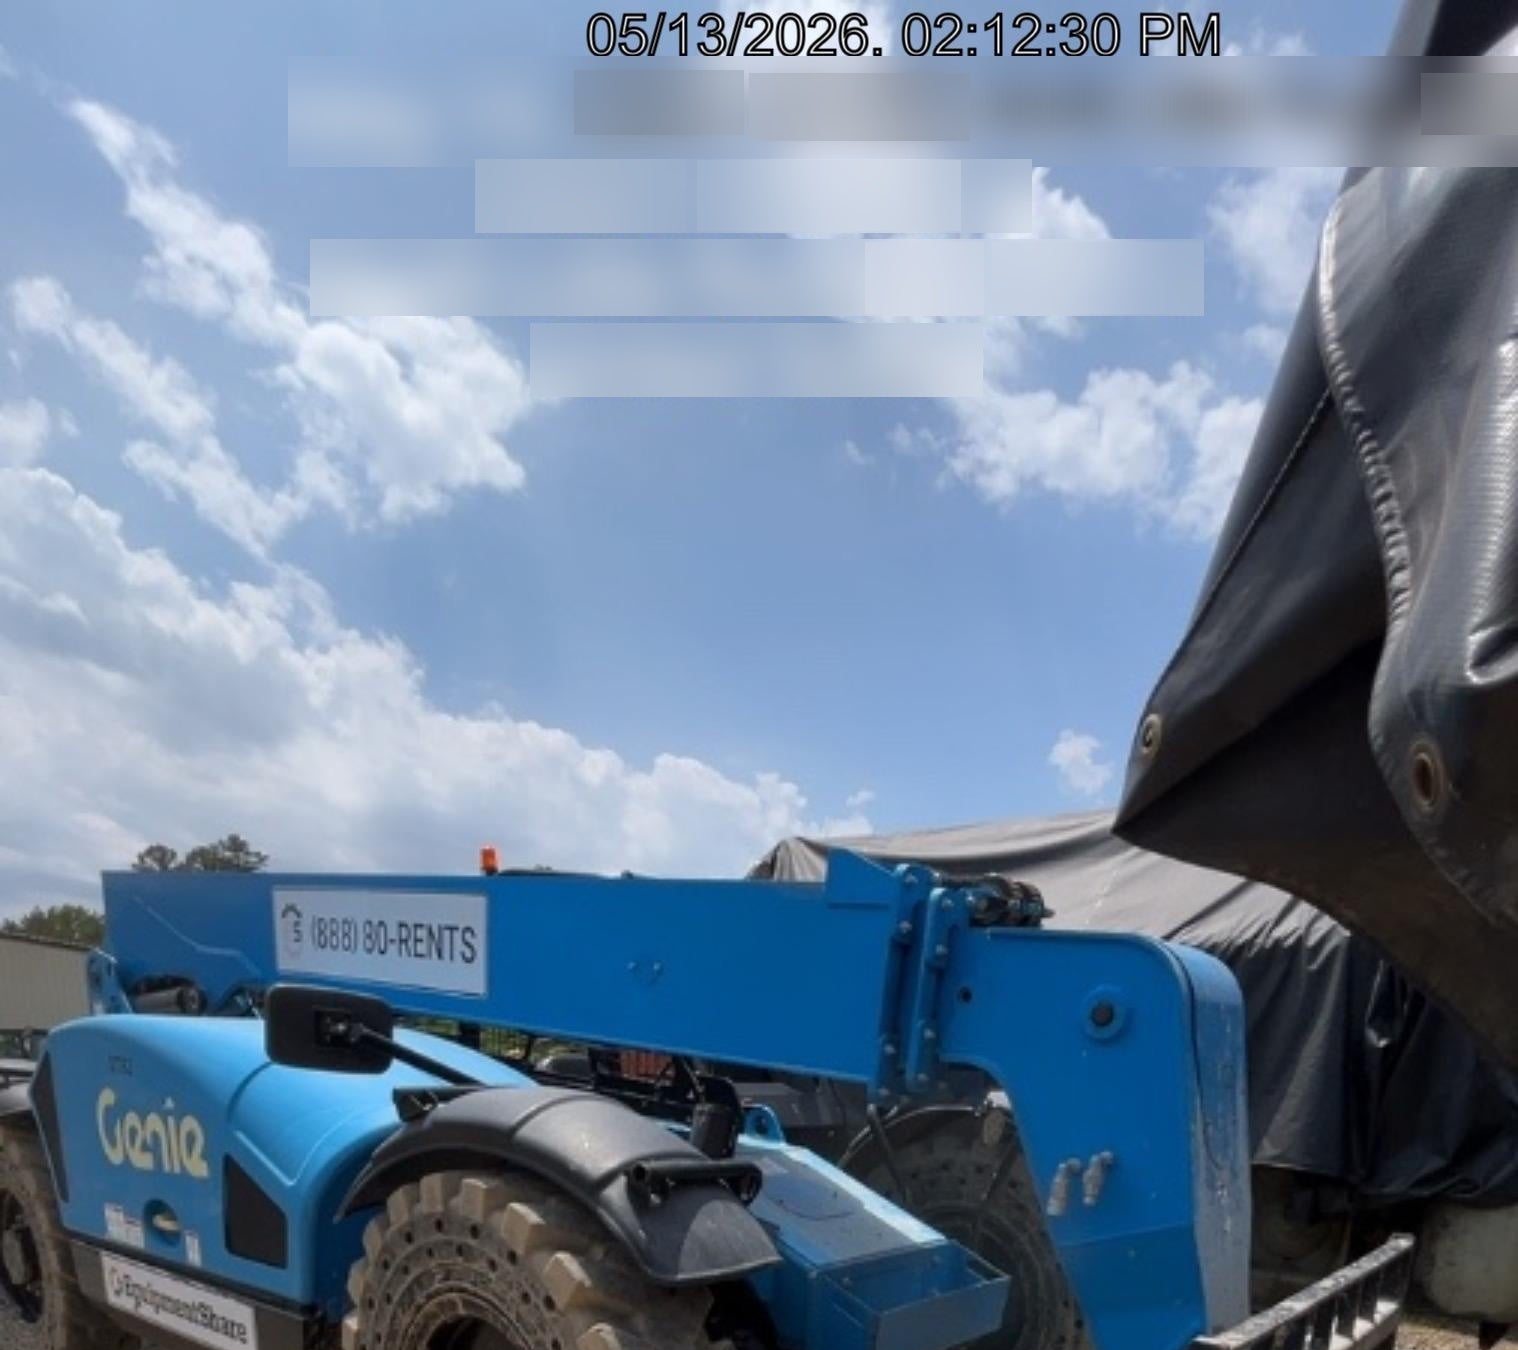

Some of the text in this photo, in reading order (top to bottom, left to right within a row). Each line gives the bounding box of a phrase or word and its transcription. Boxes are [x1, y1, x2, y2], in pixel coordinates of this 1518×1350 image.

[311, 914, 478, 963] (888) 80-RENTS
[95, 1087, 208, 1179] Genie
[122, 1274, 248, 1344] EquipmentShare
